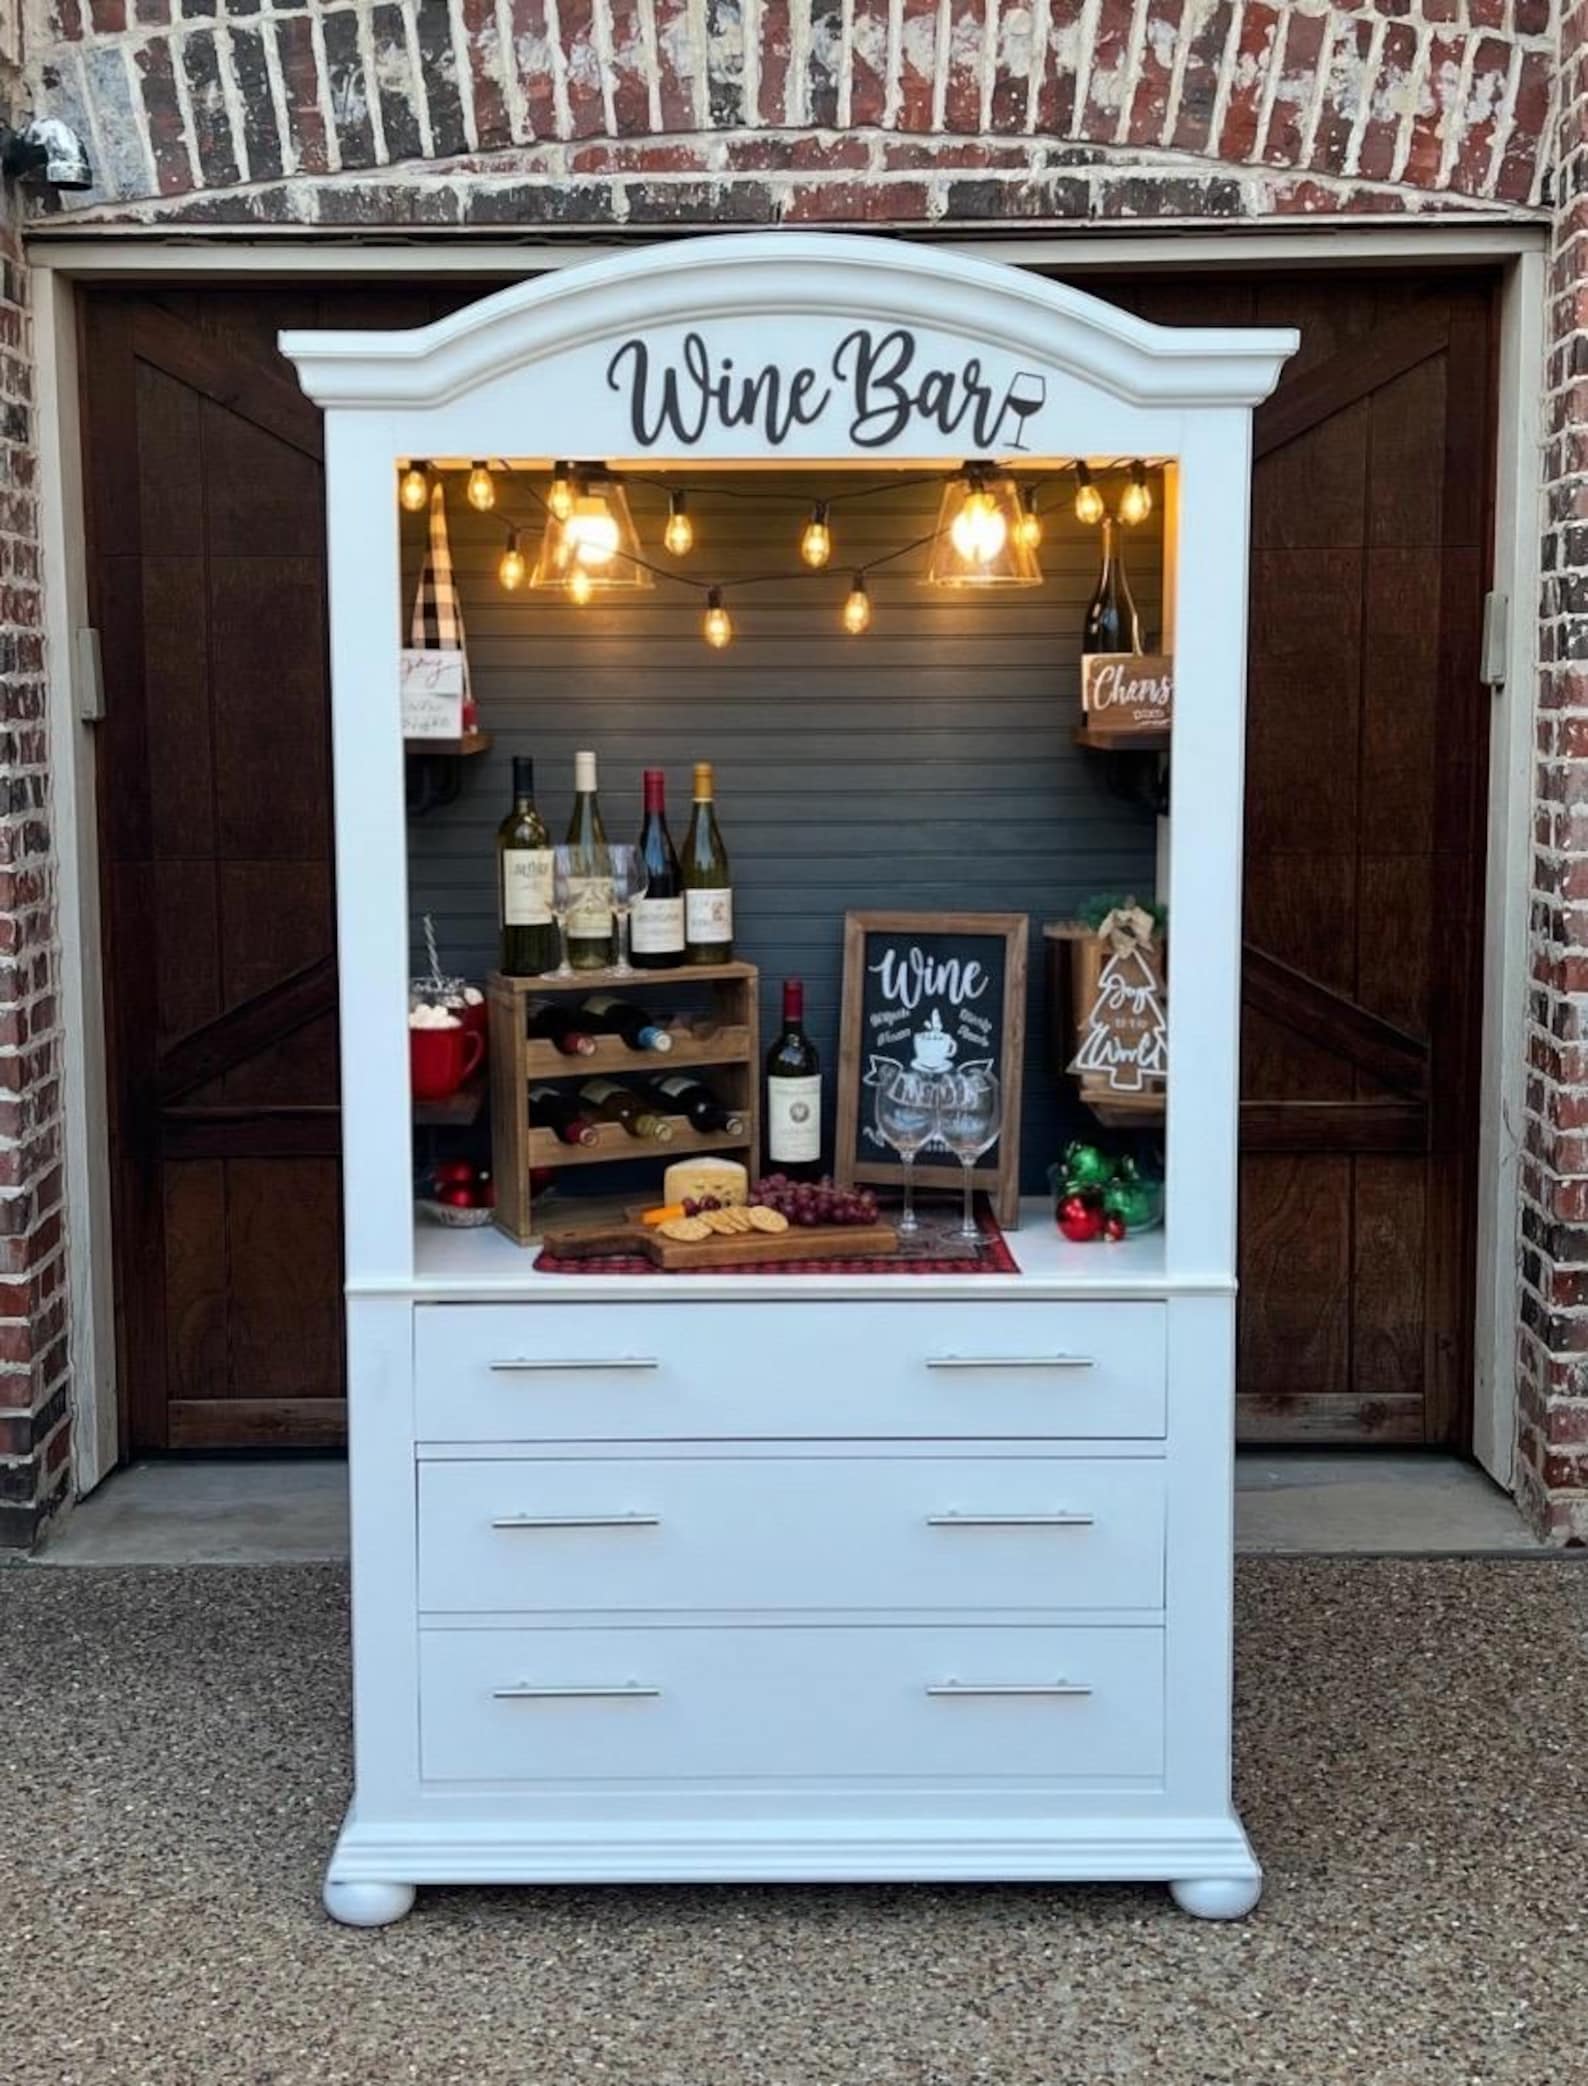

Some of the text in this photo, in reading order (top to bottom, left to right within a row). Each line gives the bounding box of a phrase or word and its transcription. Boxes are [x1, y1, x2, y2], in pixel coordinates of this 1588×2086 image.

[606, 329, 1008, 449] Wine Bar
[868, 947, 990, 1009] Wine
